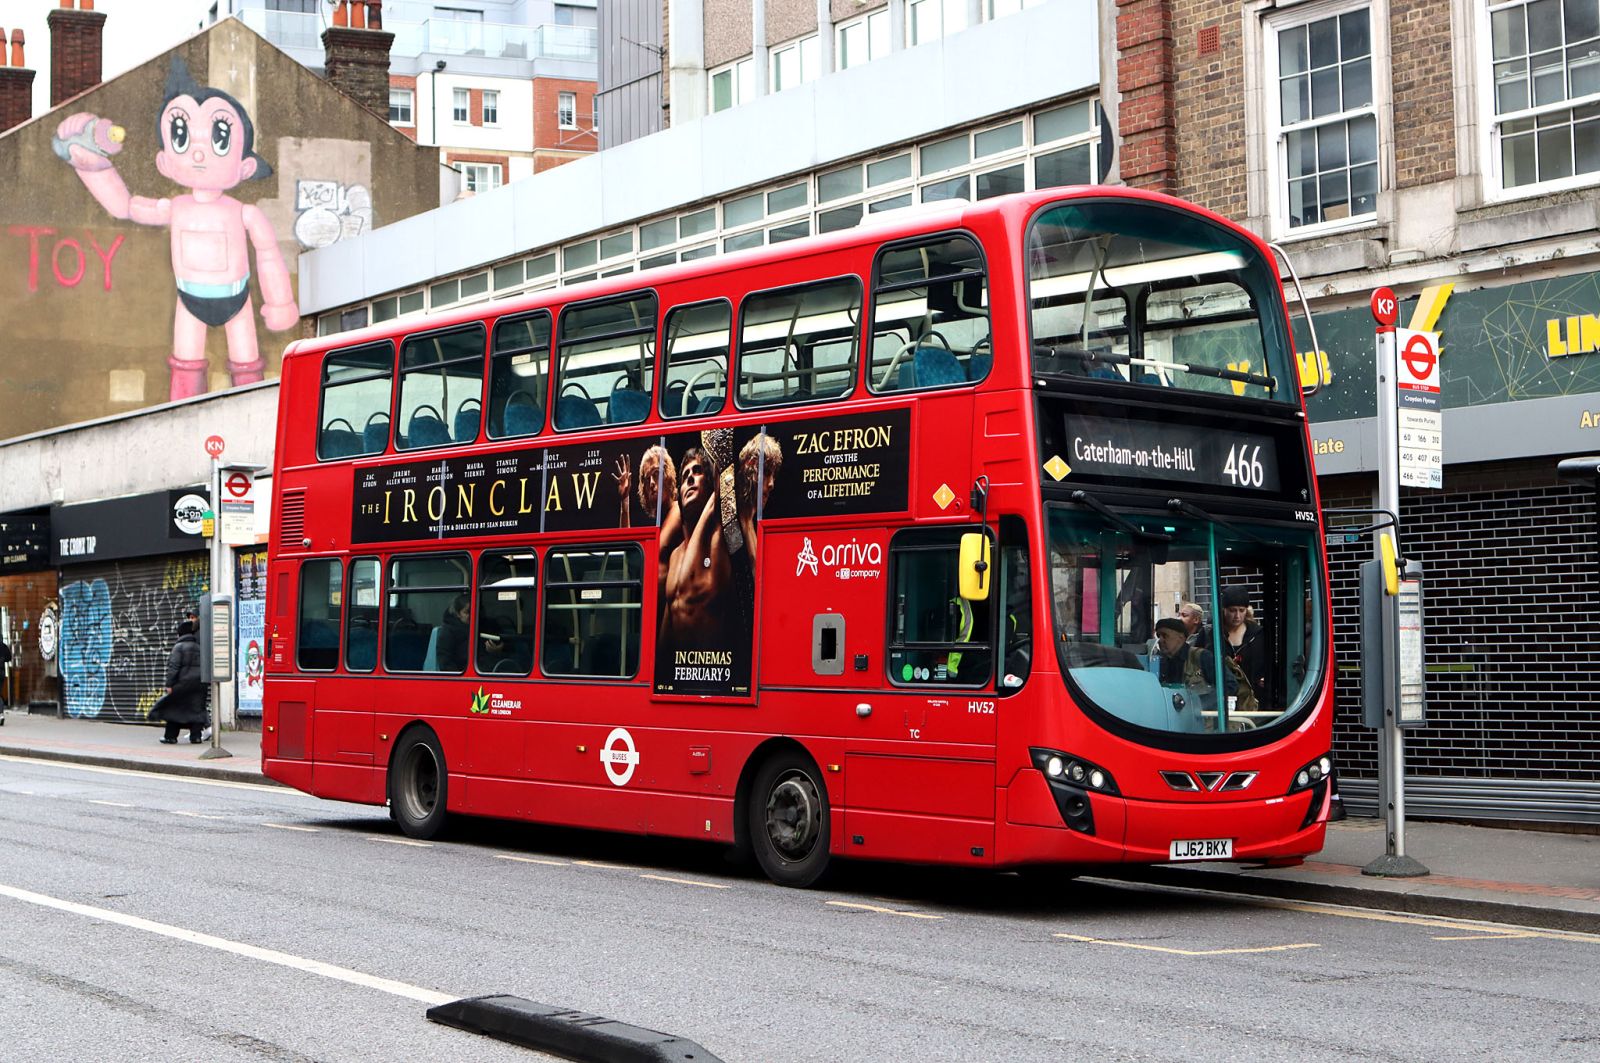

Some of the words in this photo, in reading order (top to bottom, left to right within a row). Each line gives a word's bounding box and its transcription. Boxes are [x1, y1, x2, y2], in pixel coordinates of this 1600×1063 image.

[9, 226, 125, 292] TOY
[1378, 299, 1394, 314] KP
[1404, 395, 1422, 403] Croydon
[833, 426, 892, 451] EFRON
[207, 441, 223, 450] KN
[1313, 438, 1345, 455] late
[588, 450, 600, 458] LILY
[824, 455, 844, 465] GIVES
[844, 453, 858, 462] THE
[1074, 437, 1196, 472] Caterham-on-the-Hill
[466, 462, 484, 470] MAURA
[496, 458, 518, 467] STANLEY
[584, 458, 602, 467] JAMES
[1223, 444, 1264, 488] 466
[392, 470, 411, 478] JEREMY
[464, 470, 485, 478] TIERNEY
[496, 466, 517, 475] SIMONS
[803, 464, 880, 483] PERFORMANCE
[386, 478, 401, 486] ALLEN
[361, 503, 380, 515] THE
[383, 471, 602, 525] IRONCLAW
[807, 490, 818, 500] OF
[817, 490, 823, 499] A
[1295, 510, 1315, 522] HV52
[455, 522, 479, 531] DIRECTED
[486, 521, 499, 529] SEAN
[499, 520, 518, 528] DURKIN
[822, 538, 882, 566] arriva
[850, 570, 880, 579] company
[675, 651, 687, 664] IN
[687, 651, 732, 665] CINEMAS
[674, 667, 724, 681] FEBRUARY
[724, 668, 731, 681] 9
[967, 701, 995, 714] HV52
[909, 728, 920, 739] TC
[612, 752, 627, 761] BUSES
[1174, 841, 1204, 857] LJ62
[1205, 840, 1227, 856] BKX
